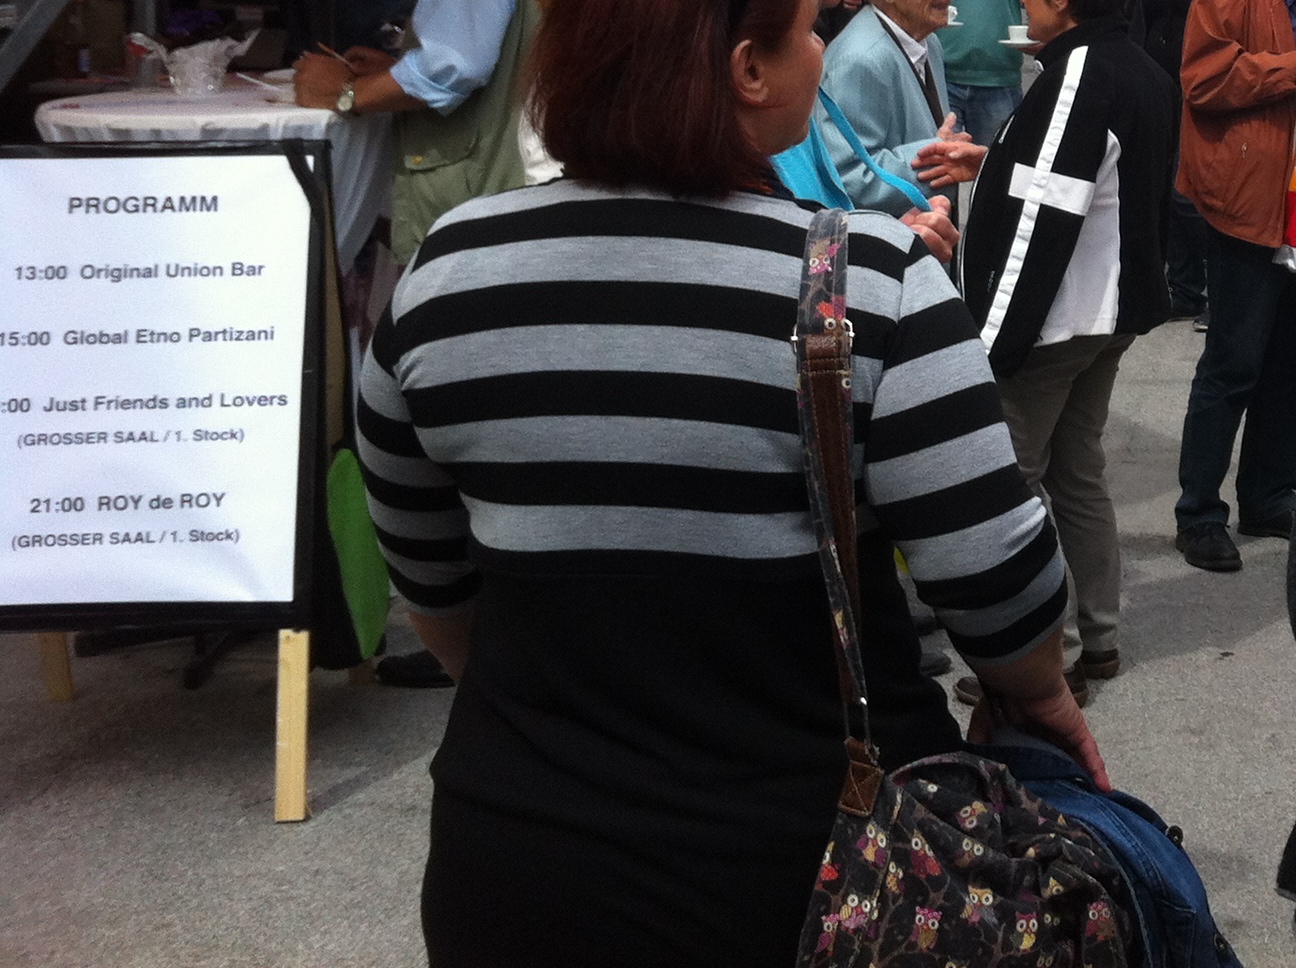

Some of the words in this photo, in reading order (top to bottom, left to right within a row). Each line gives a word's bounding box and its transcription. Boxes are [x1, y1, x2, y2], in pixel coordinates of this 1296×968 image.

[67, 195, 219, 215] PROGRAMM
[15, 265, 67, 281] 13:00
[79, 263, 158, 283] Original
[165, 262, 224, 278] Union
[231, 261, 265, 277] Bar
[0, 331, 51, 346] 15:00
[63, 329, 128, 345] Global
[135, 328, 181, 344] Etno
[188, 326, 275, 343] Partizani
[43, 396, 87, 413] Just
[93, 394, 169, 411] Friends
[175, 393, 213, 409] and
[220, 392, 288, 408] Lovers
[17, 431, 107, 449] (GROSSER
[113, 430, 159, 444] SAAL
[175, 430, 188, 443] 1.
[192, 428, 245, 444] Stock)
[30, 496, 85, 514] 21:00
[98, 494, 143, 511] ROY
[148, 493, 174, 510] de
[179, 492, 226, 509] ROY
[11, 533, 103, 551] (GROSSER
[109, 531, 155, 545] SAAL
[170, 530, 184, 544] 1.
[189, 529, 240, 545] Stock)
